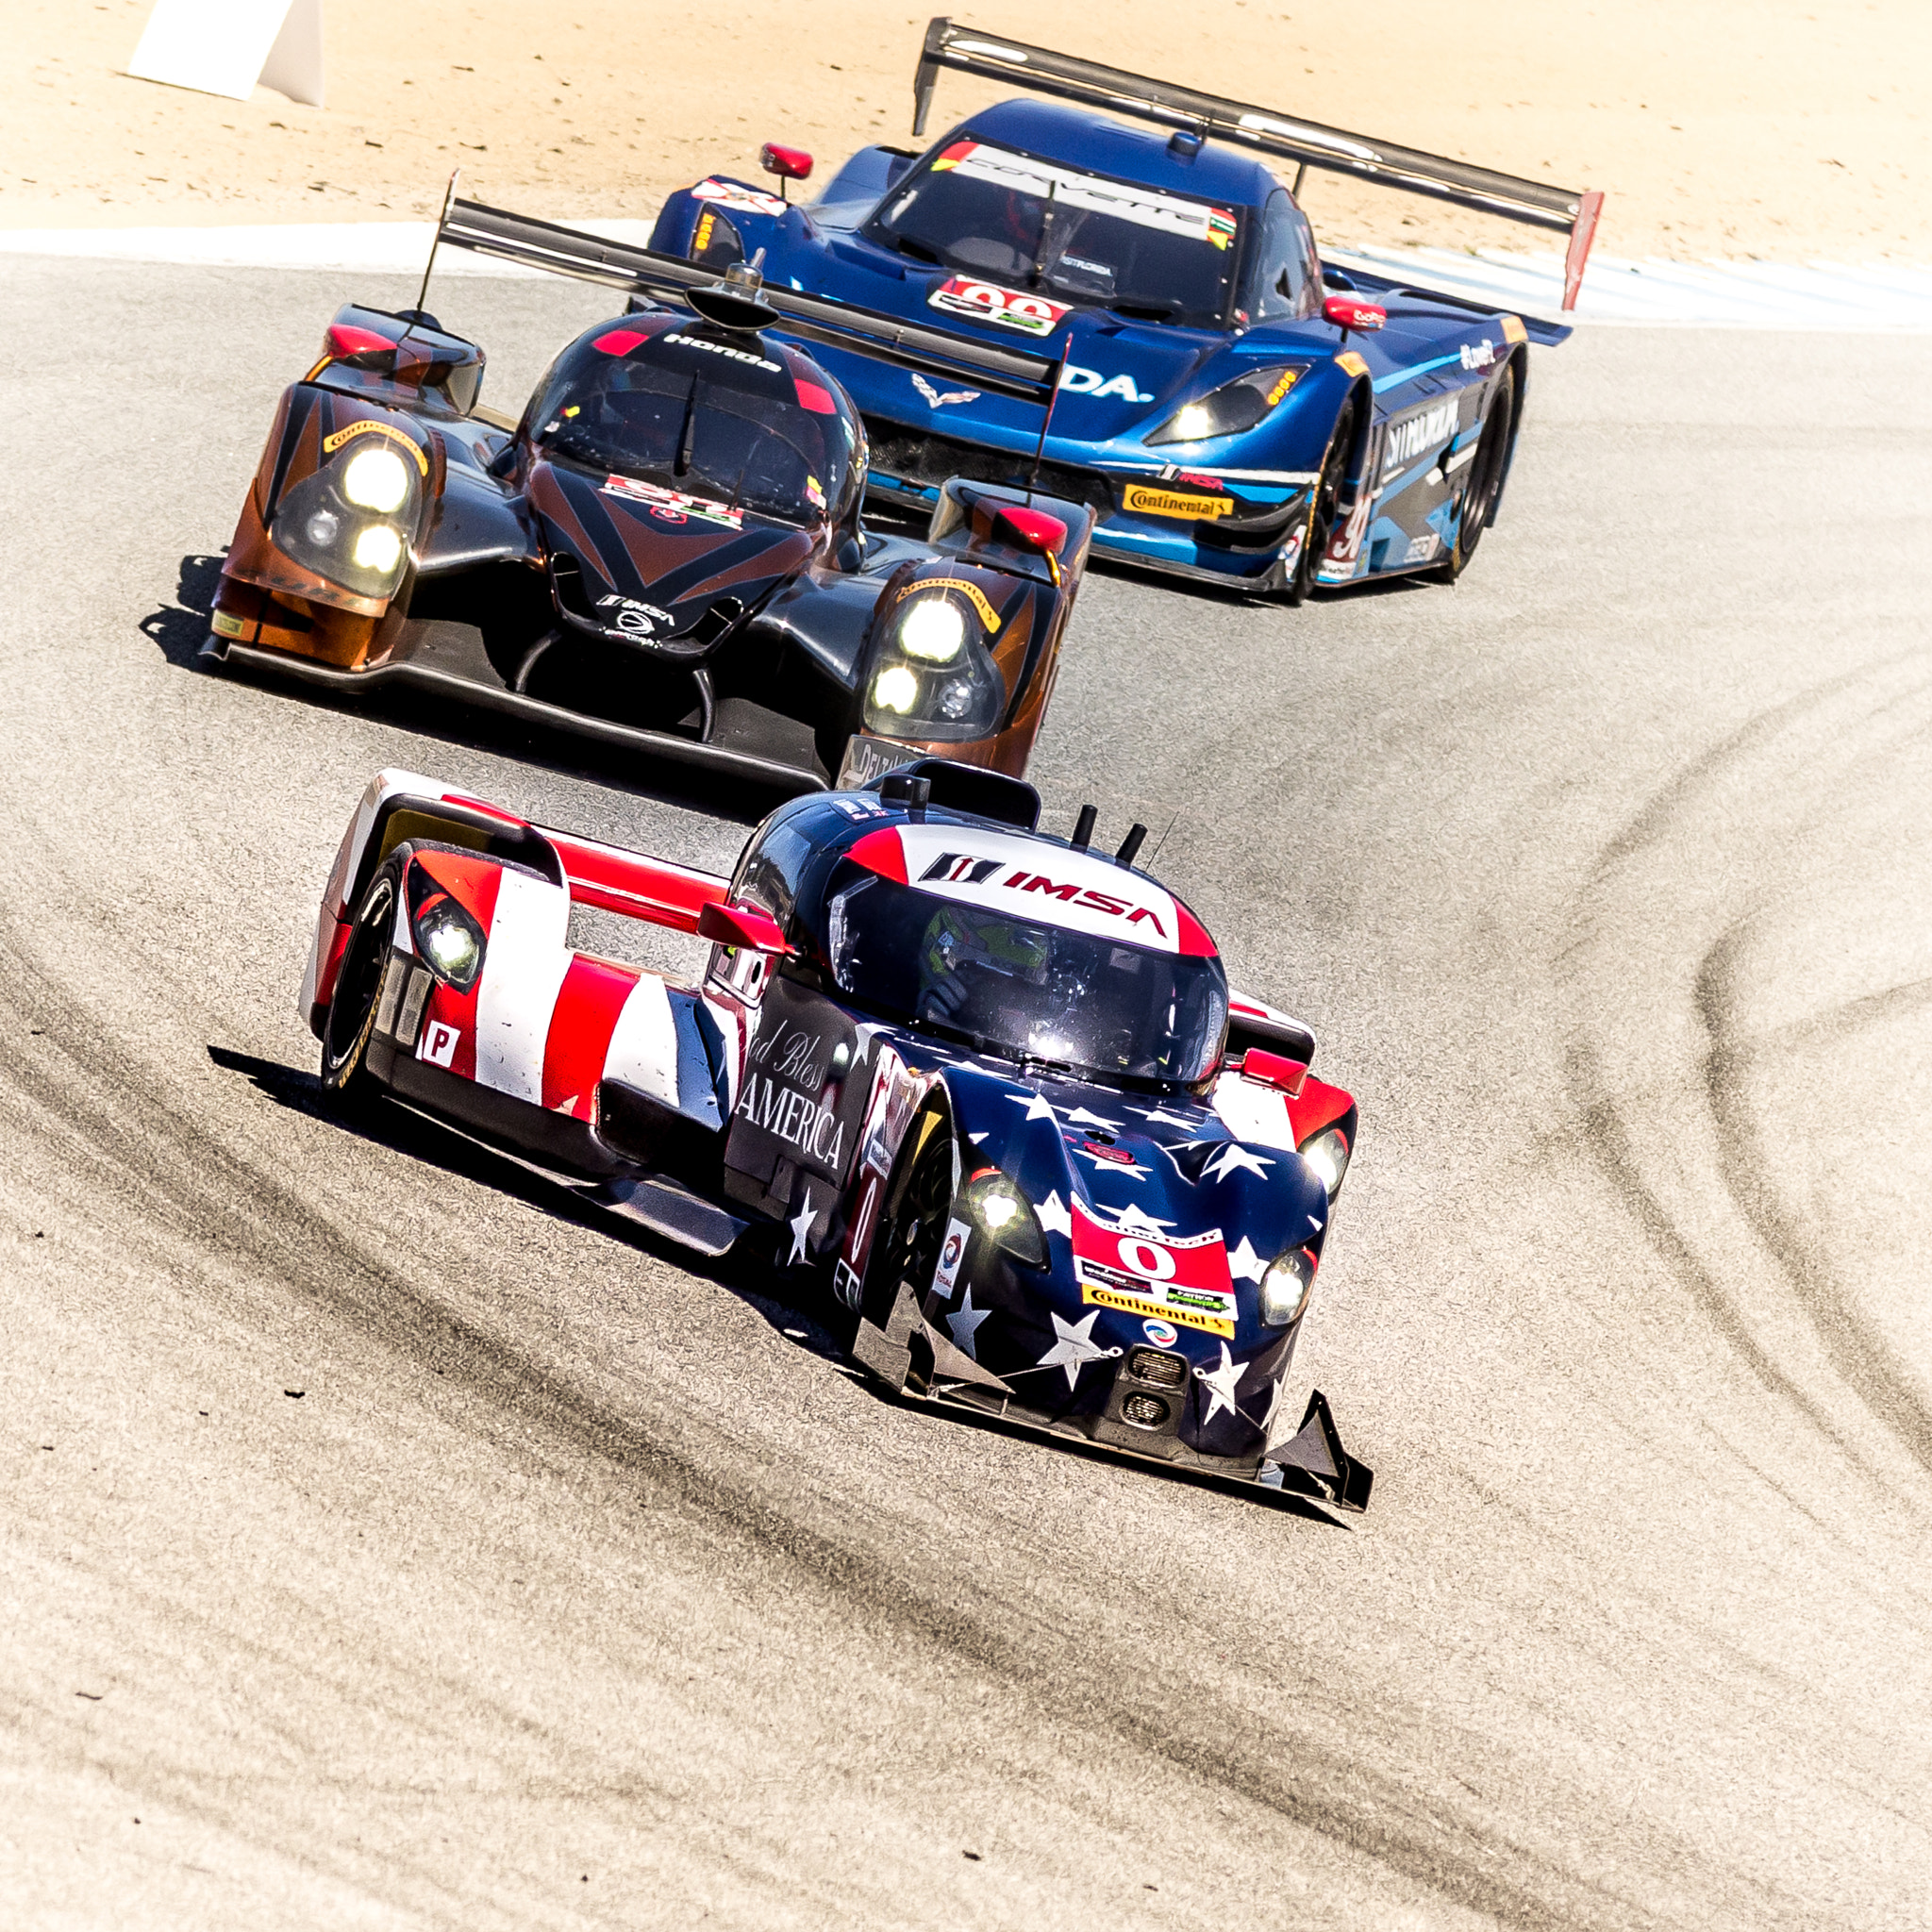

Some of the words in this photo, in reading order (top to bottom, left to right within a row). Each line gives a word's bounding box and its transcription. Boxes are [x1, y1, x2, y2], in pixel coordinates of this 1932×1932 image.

[663, 333, 782, 373] Honda
[1130, 490, 1215, 516] Continental
[1003, 871, 1169, 940] IMSA
[430, 1027, 450, 1058] P
[748, 1019, 788, 1064] od
[773, 1031, 825, 1091] Bless
[735, 1072, 845, 1171] AMERICA
[851, 1177, 877, 1265] 0
[1117, 1236, 1177, 1281] 0
[1091, 1289, 1208, 1325] Continental
